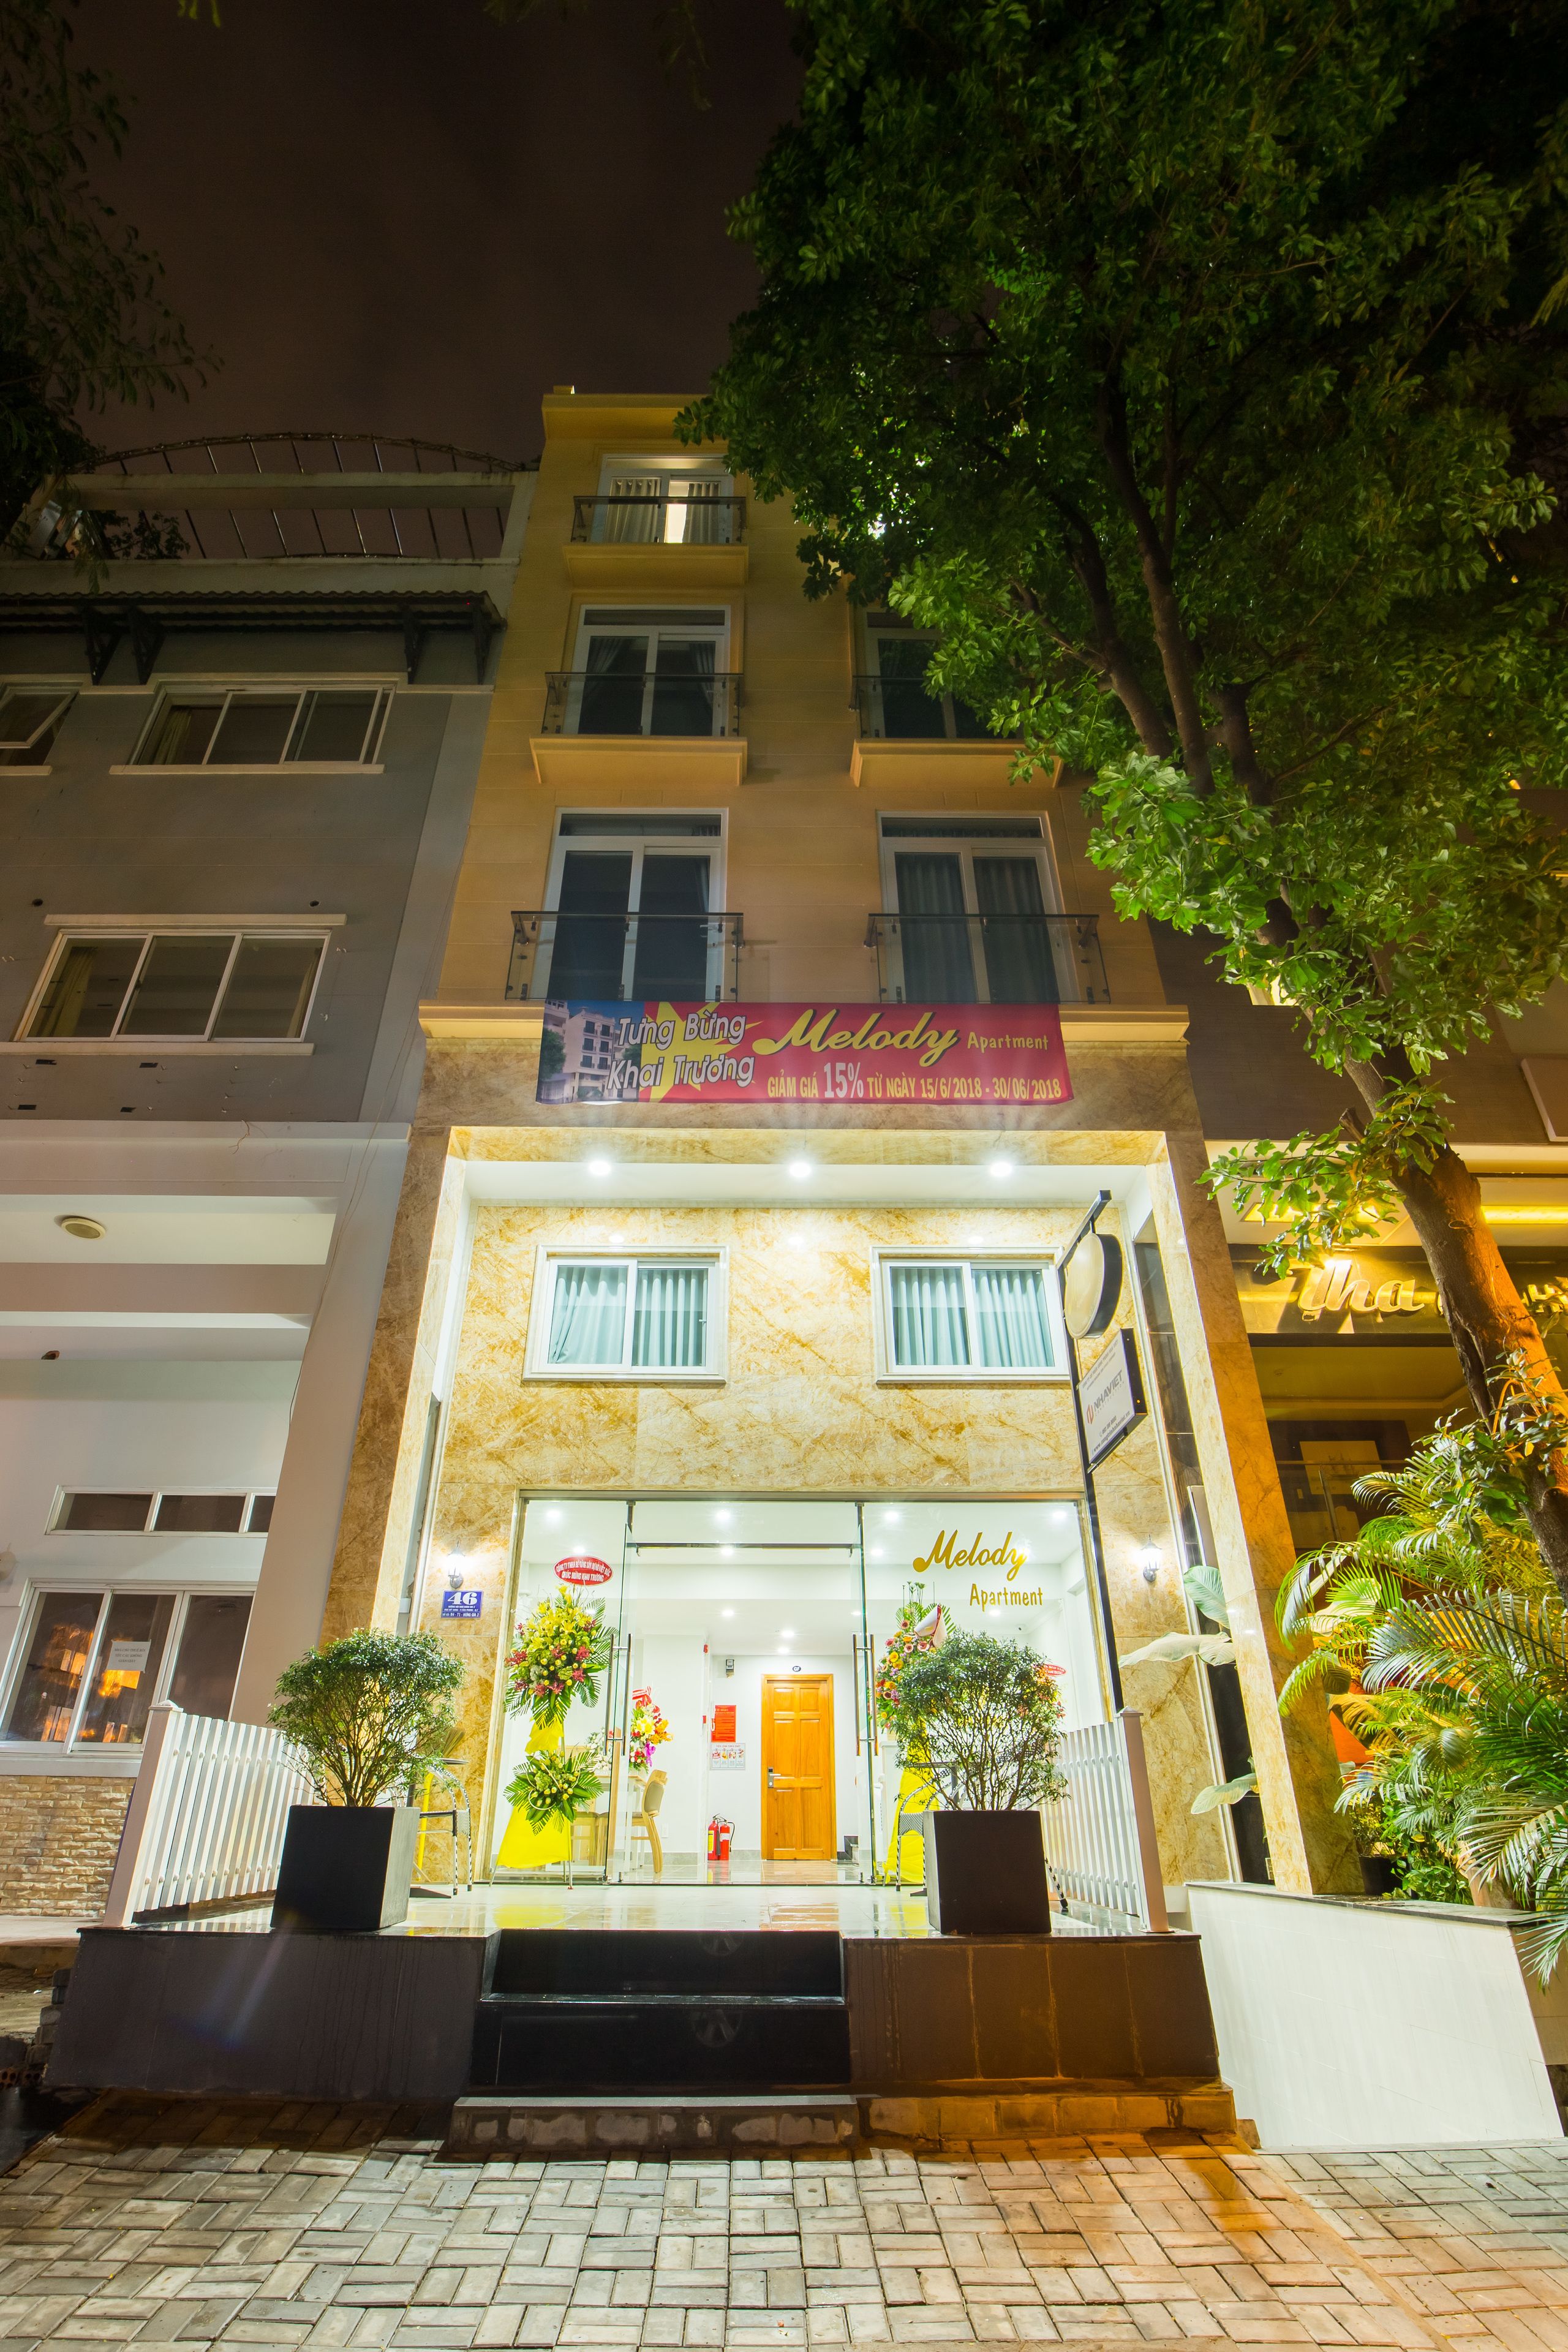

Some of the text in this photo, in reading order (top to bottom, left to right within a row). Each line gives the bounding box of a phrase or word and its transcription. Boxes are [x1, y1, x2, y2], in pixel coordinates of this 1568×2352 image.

[618, 1009, 746, 1050] Tưng Bừng
[752, 1009, 1048, 1068] Melody Apartment
[606, 1054, 755, 1090] Khai Trương
[767, 1069, 796, 1098] GIẢM
[799, 1072, 818, 1098] GIÁ
[824, 1062, 864, 1098] 15%
[867, 1072, 883, 1098] TỪ
[886, 1072, 916, 1098] NGÀY
[921, 1077, 982, 1098] 15/6/2018
[992, 1077, 1062, 1099] 30/06/2018
[1093, 1370, 1123, 1410] NHAVIET
[913, 1529, 1028, 1581] Melody
[447, 1592, 477, 1605] 46
[970, 1583, 1043, 1612] Apartment
